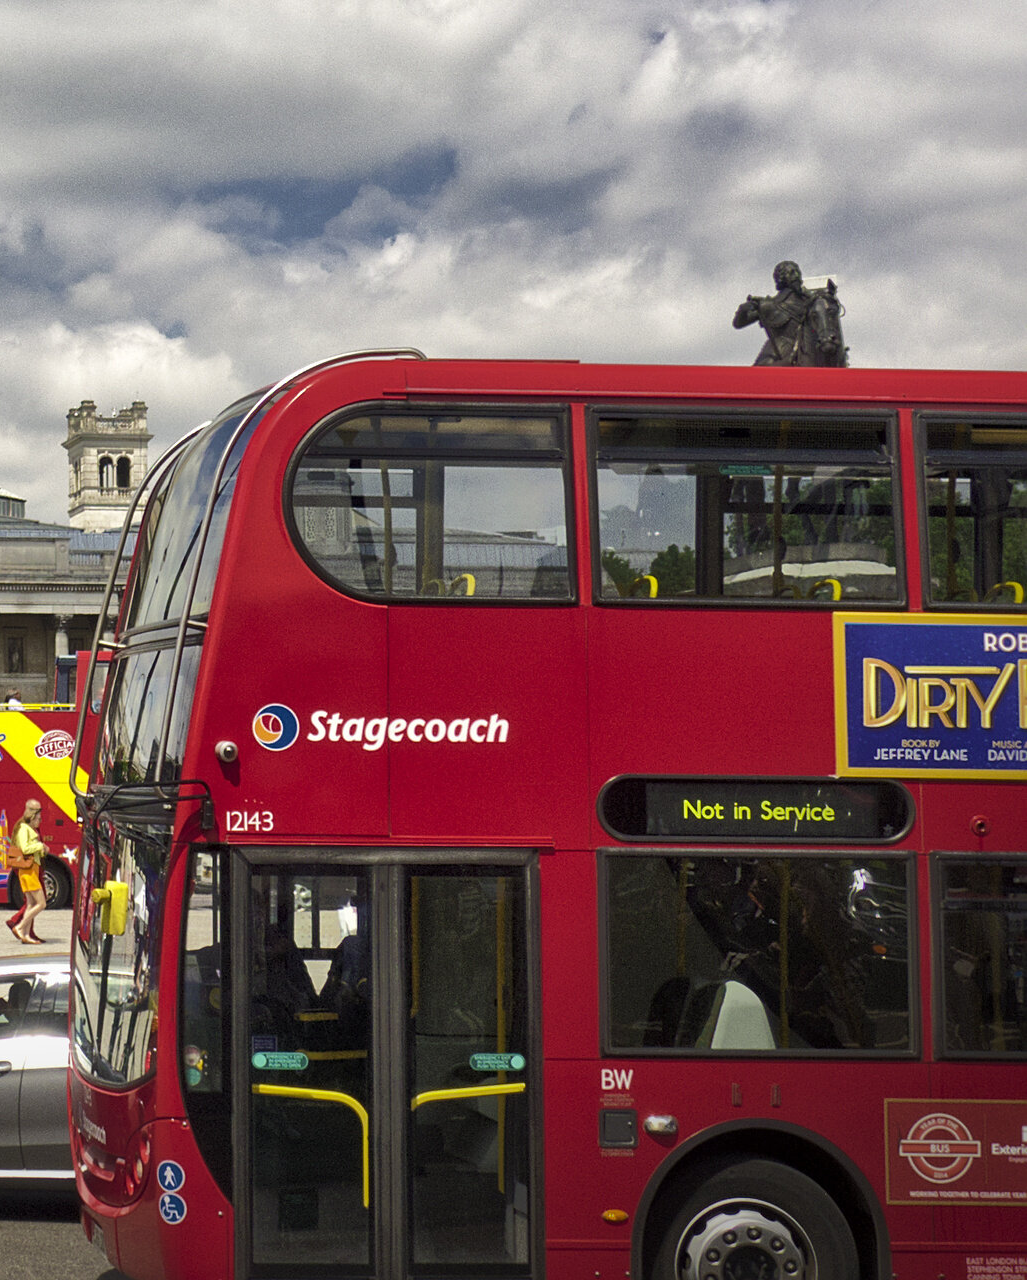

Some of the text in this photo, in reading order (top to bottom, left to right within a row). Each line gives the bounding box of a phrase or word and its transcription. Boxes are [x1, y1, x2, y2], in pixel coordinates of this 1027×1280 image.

[307, 710, 509, 751] Stagecoach
[901, 739, 940, 748] BOOK BY
[992, 740, 1022, 749] MUSIC
[874, 748, 968, 761] JEFFREY LANE
[988, 749, 1027, 761] DAVID
[683, 799, 835, 821] Not in Service
[226, 811, 274, 831] 12143
[601, 1069, 634, 1090] BW
[920, 1118, 936, 1130] YEAR
[930, 1143, 950, 1153] BUS
[966, 1257, 984, 1265] EAST
[985, 1257, 1018, 1265] LONDON
